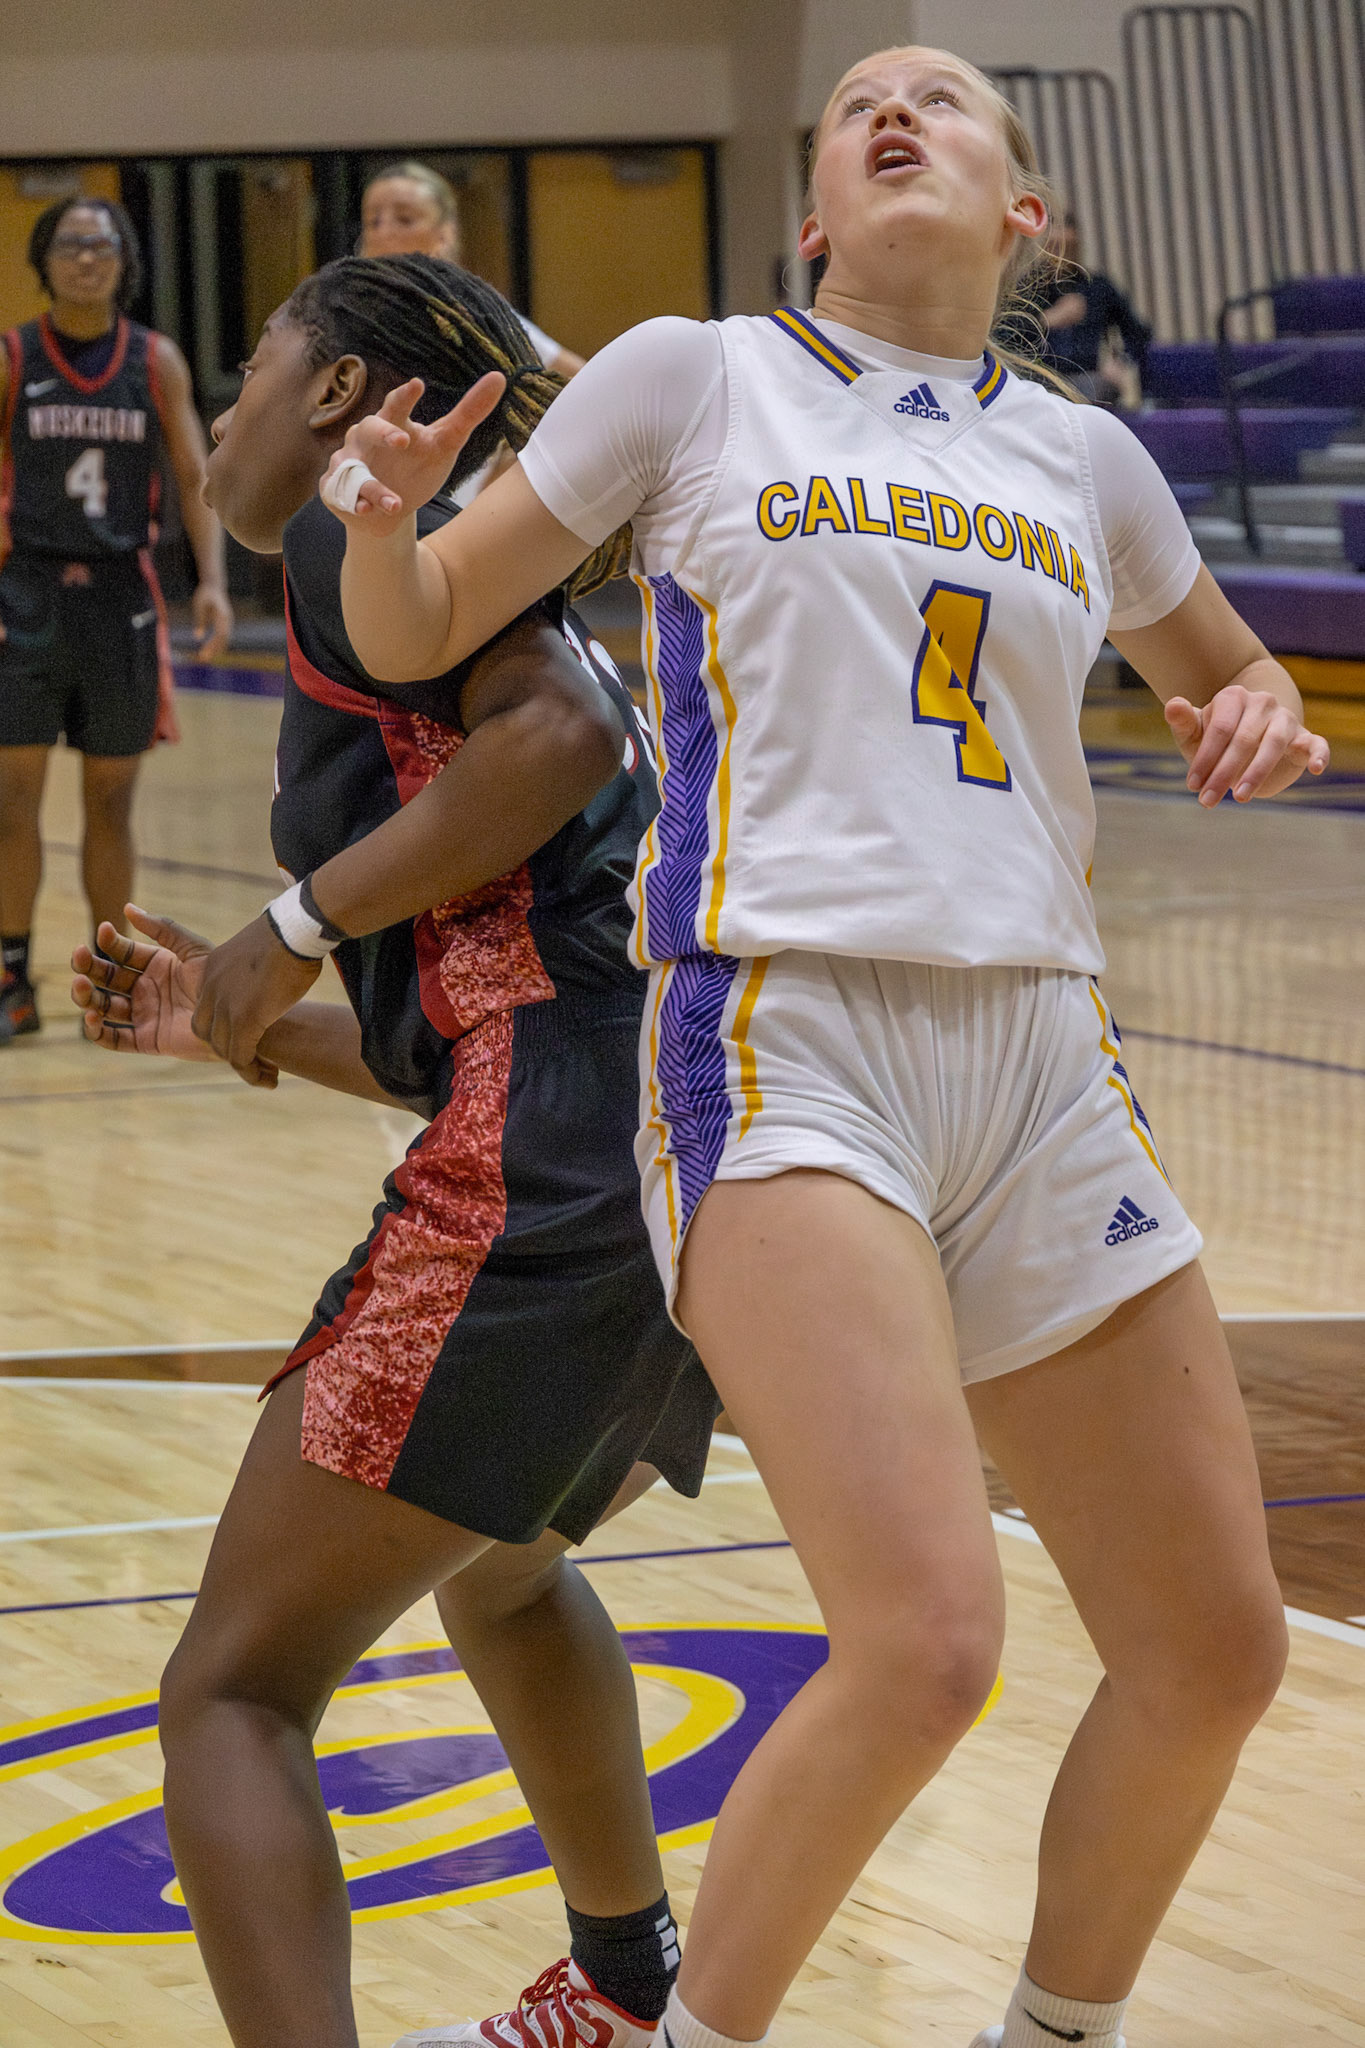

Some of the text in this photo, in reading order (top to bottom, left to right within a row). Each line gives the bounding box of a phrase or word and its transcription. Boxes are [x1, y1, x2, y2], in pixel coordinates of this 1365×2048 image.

[894, 402, 950, 422] adidas
[65, 447, 109, 518] 4
[756, 475, 1090, 614] CALEDONIA
[910, 579, 1012, 792] 4
[1104, 1217, 1159, 1246] adidas
